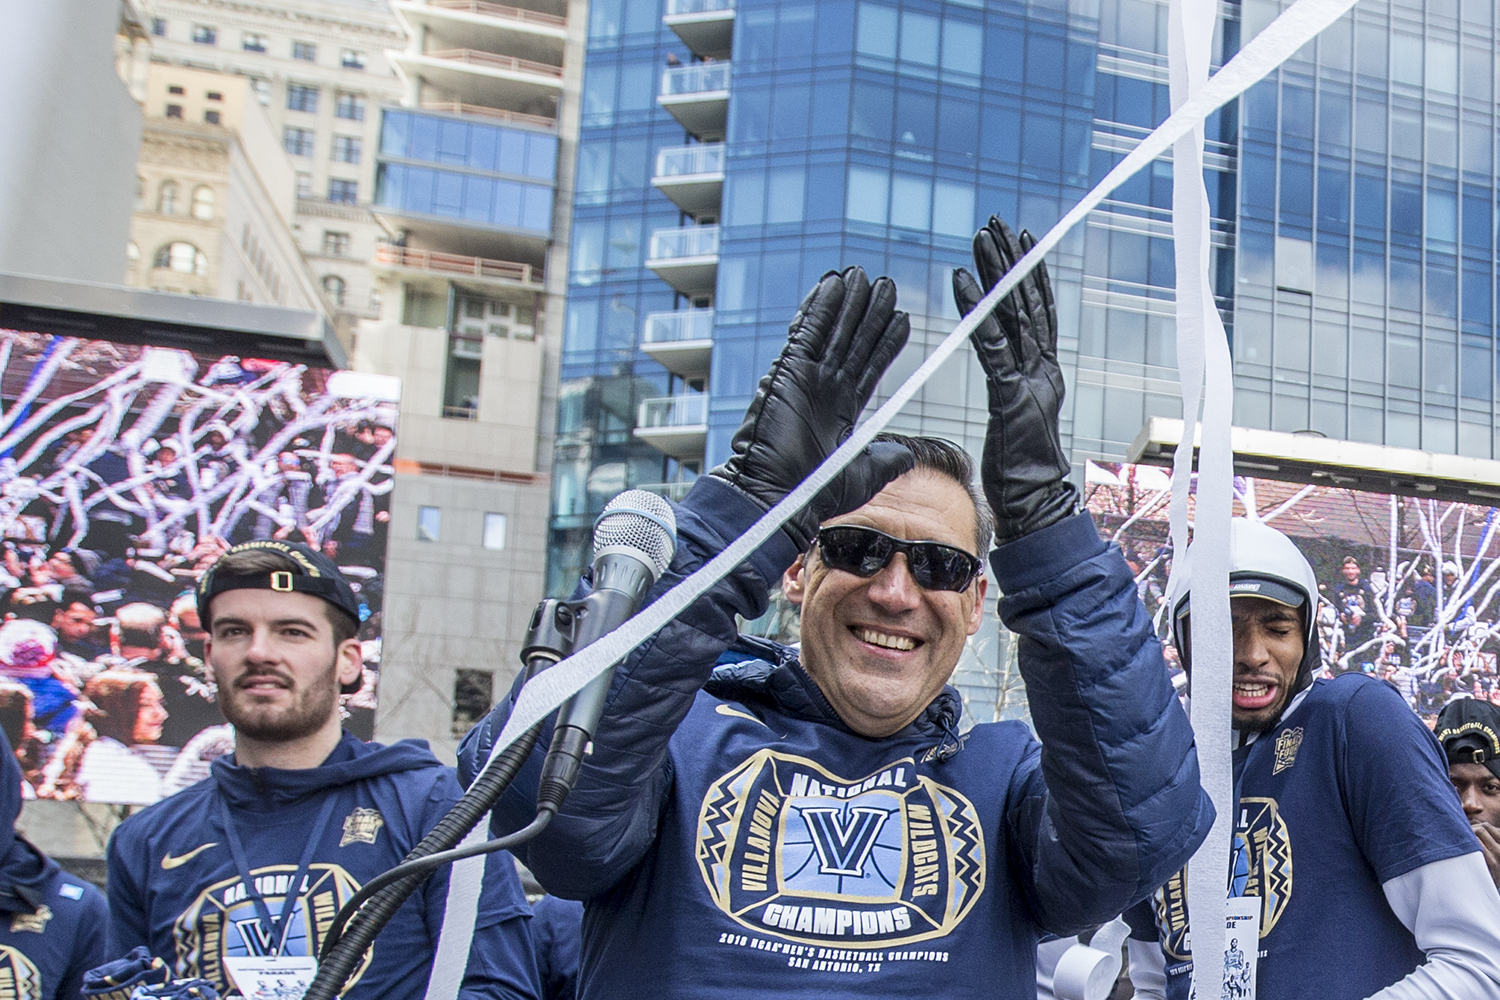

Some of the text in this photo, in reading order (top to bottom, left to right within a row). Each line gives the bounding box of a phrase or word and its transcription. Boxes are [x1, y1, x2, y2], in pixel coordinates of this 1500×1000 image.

[789, 767, 908, 798] NATIONAL
[741, 788, 781, 891] VILLANOVA
[907, 803, 939, 898] WILDCATS
[761, 903, 912, 935] CHAMPIONS
[788, 957, 882, 973] SAN ANTONIO, TX
[817, 949, 884, 962] BASKETBALL
[887, 952, 949, 963] CHAMPIONS
